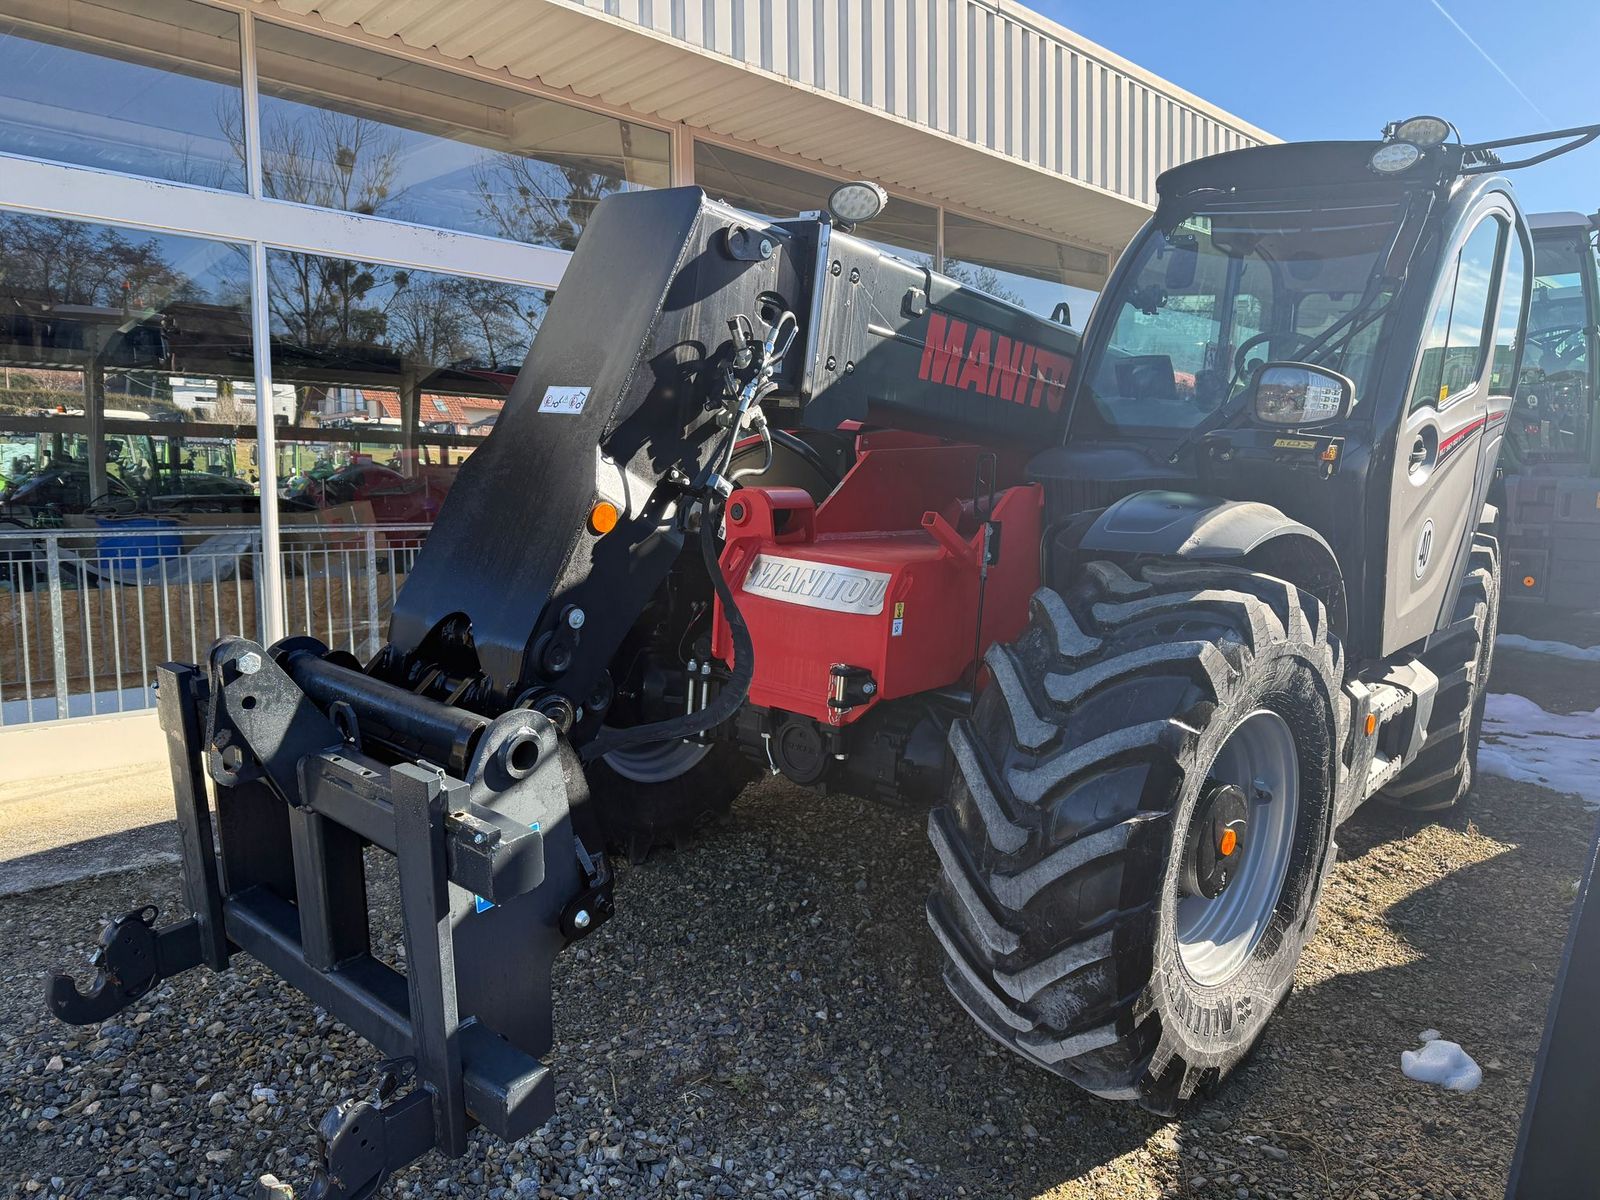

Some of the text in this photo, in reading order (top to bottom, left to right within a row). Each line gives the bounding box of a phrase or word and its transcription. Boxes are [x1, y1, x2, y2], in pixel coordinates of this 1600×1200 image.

[918, 312, 1073, 413] MANITO
[1418, 530, 1432, 567] 40
[752, 561, 887, 608] MANITOU
